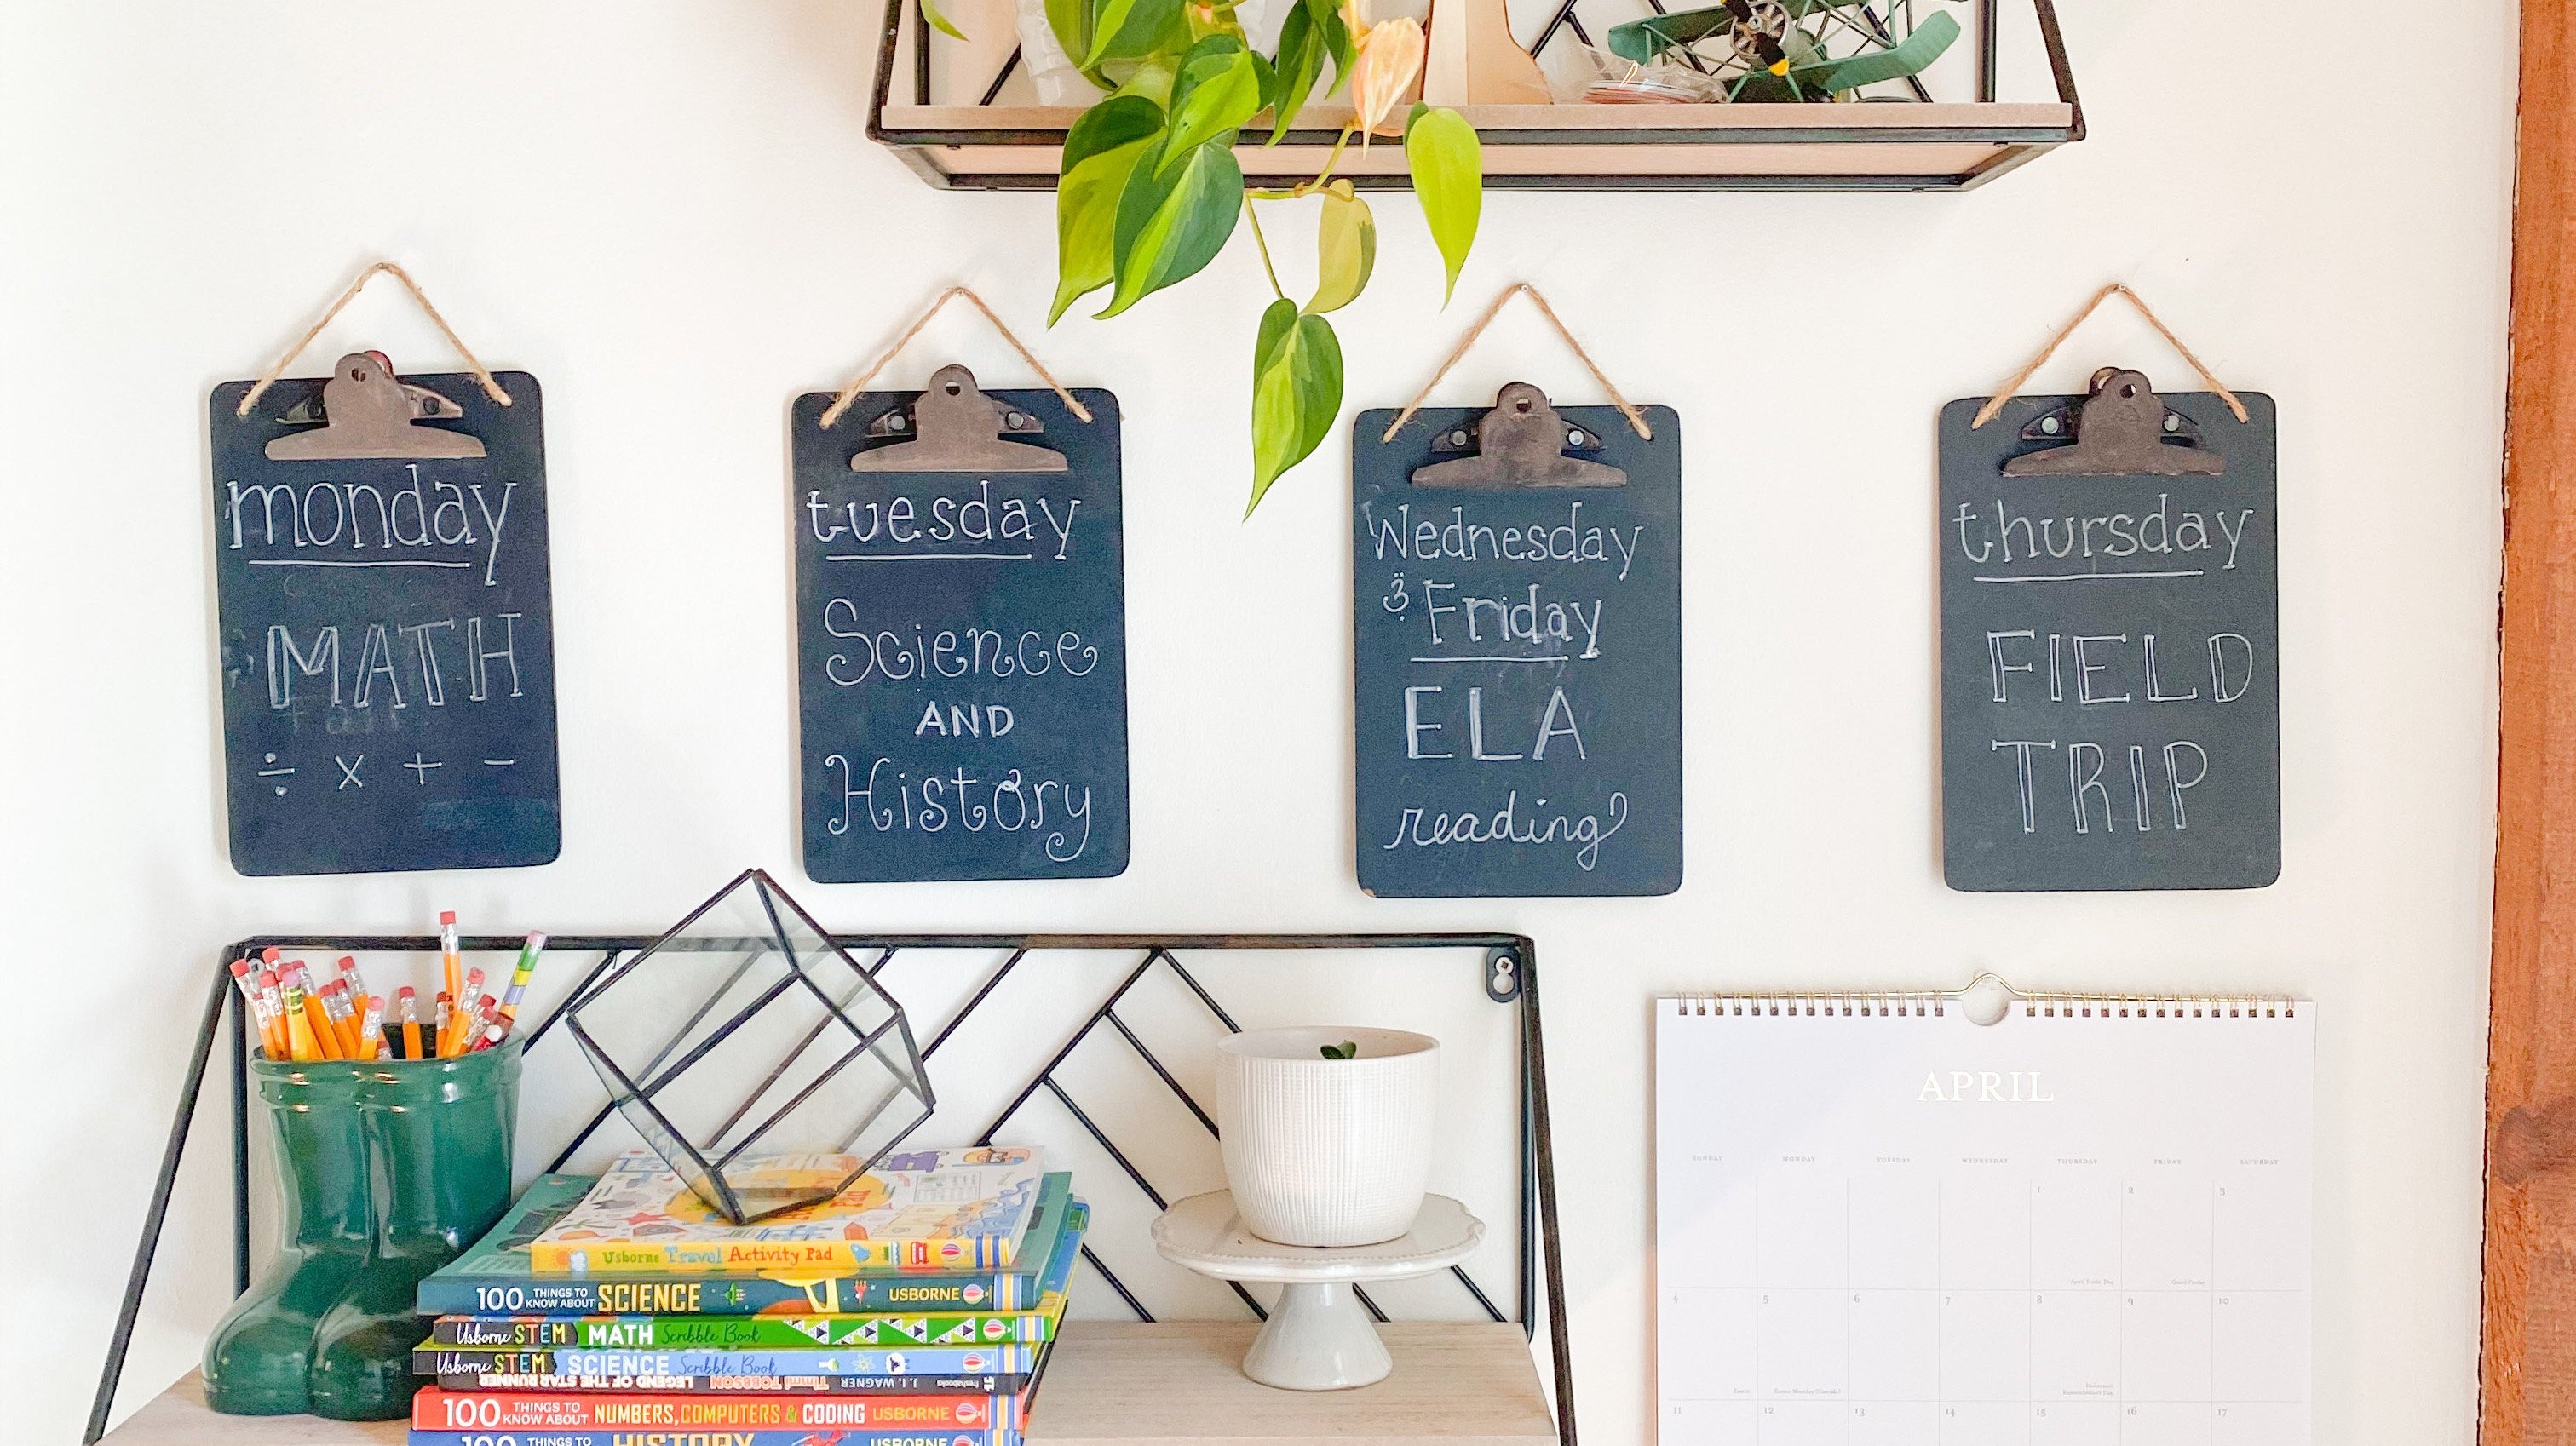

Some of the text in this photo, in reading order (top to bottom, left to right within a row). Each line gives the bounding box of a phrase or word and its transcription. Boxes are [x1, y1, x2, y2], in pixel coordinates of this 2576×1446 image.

[225, 463, 518, 586] monday
[805, 479, 1082, 560] tuesday
[1952, 493, 2254, 569] thursday
[1362, 501, 1644, 581] Wednesday
[1423, 579, 1602, 659] Friday
[824, 598, 1099, 686] Science
[267, 612, 523, 710] MATH
[1987, 628, 2253, 704] FIELD
[914, 700, 1015, 739] AND
[1404, 685, 1586, 761] ELA
[1991, 738, 2208, 835] TRIP
[824, 753, 1090, 863] History
[1383, 789, 1629, 872] reading
[1915, 1070, 2054, 1102] APRIL
[2219, 1187, 2226, 1196] 3
[602, 1246, 832, 1265] Usborne Travel Activity Pad
[476, 1287, 525, 1311] 100
[532, 1288, 589, 1299] THINGS TO
[597, 1283, 702, 1313] SCIENCE
[888, 1287, 960, 1302] USBORNE
[1762, 1294, 1769, 1305] 5
[1854, 1294, 1861, 1304] 6
[1944, 1295, 1952, 1306] 7
[2036, 1294, 2043, 1305] 8
[2218, 1297, 2230, 1305] 10
[525, 1298, 595, 1309] KNOW ABOUT
[2127, 1296, 2134, 1309] 9
[457, 1322, 761, 1346] Usborne STEM MATH Scribble Book
[436, 1351, 778, 1376] Usborne STEM SCIENCE Scribble Book
[479, 1374, 694, 1389] LEGEND OF THE STAR RUNNER
[840, 1376, 894, 1389] WAGNER
[442, 1398, 502, 1427] 100
[513, 1402, 581, 1413] THINGS TO
[681, 1403, 781, 1425] COMPUTERS
[786, 1405, 797, 1424] &
[802, 1403, 865, 1425] CODING
[872, 1407, 951, 1421] USBORNE
[1763, 1407, 1774, 1415] 12
[1854, 1408, 1866, 1418] 13
[1946, 1408, 1957, 1418] 14
[2036, 1407, 2047, 1418] 15
[2126, 1405, 2139, 1417] 16
[2217, 1407, 2228, 1418] 17
[503, 1414, 589, 1426] KNOW ABOUT
[526, 1437, 573, 1446] THINGS
[574, 1437, 592, 1446] TO
